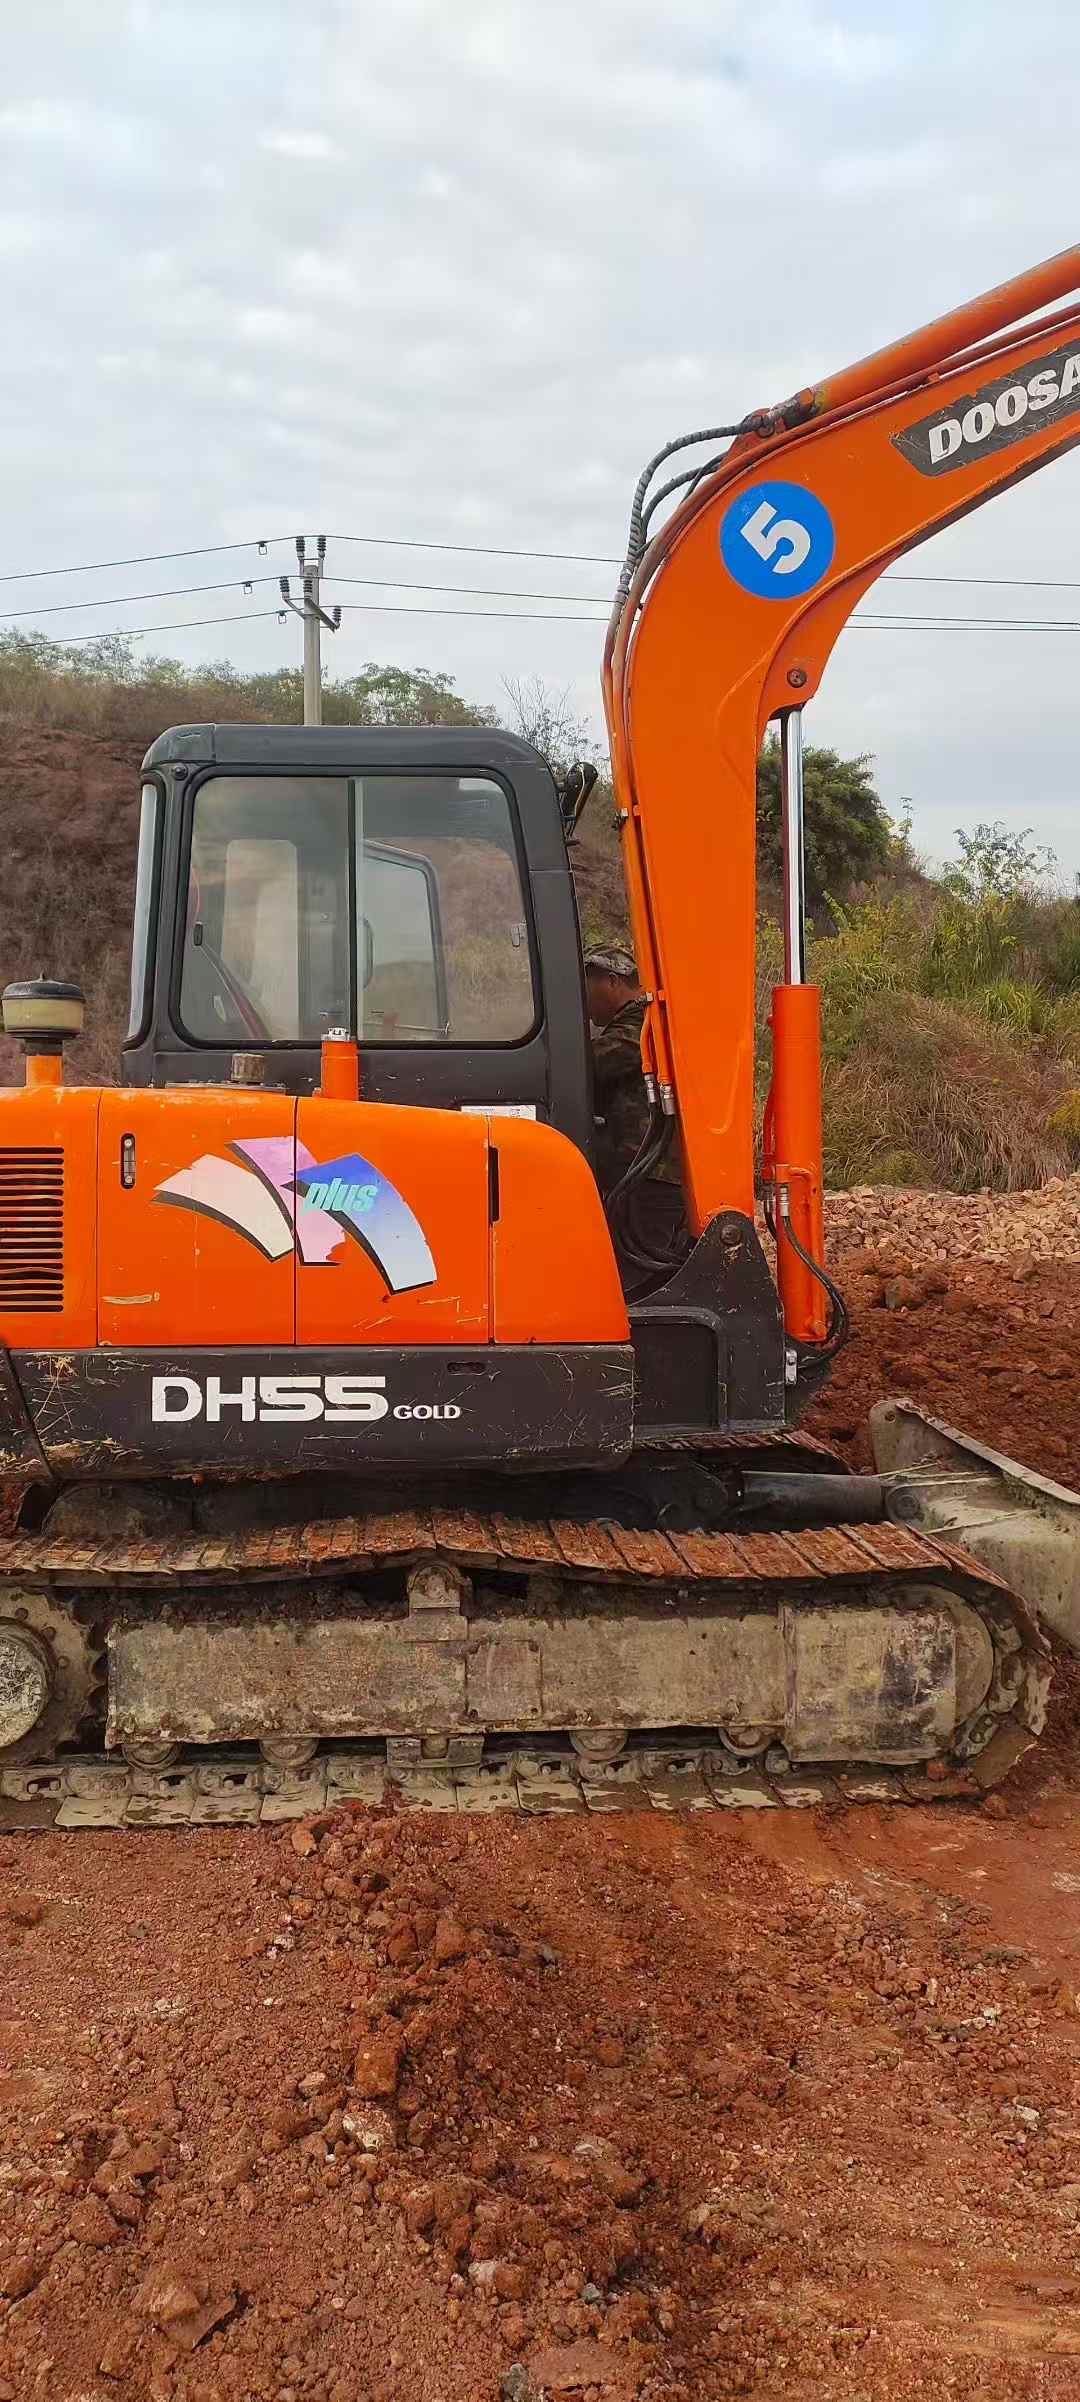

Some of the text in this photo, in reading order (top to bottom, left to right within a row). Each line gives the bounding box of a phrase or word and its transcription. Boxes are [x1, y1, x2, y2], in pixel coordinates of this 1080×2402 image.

[740, 501, 811, 574] 5
[303, 1177, 378, 1215] plus
[151, 1376, 462, 1422] DH55 GOLD
